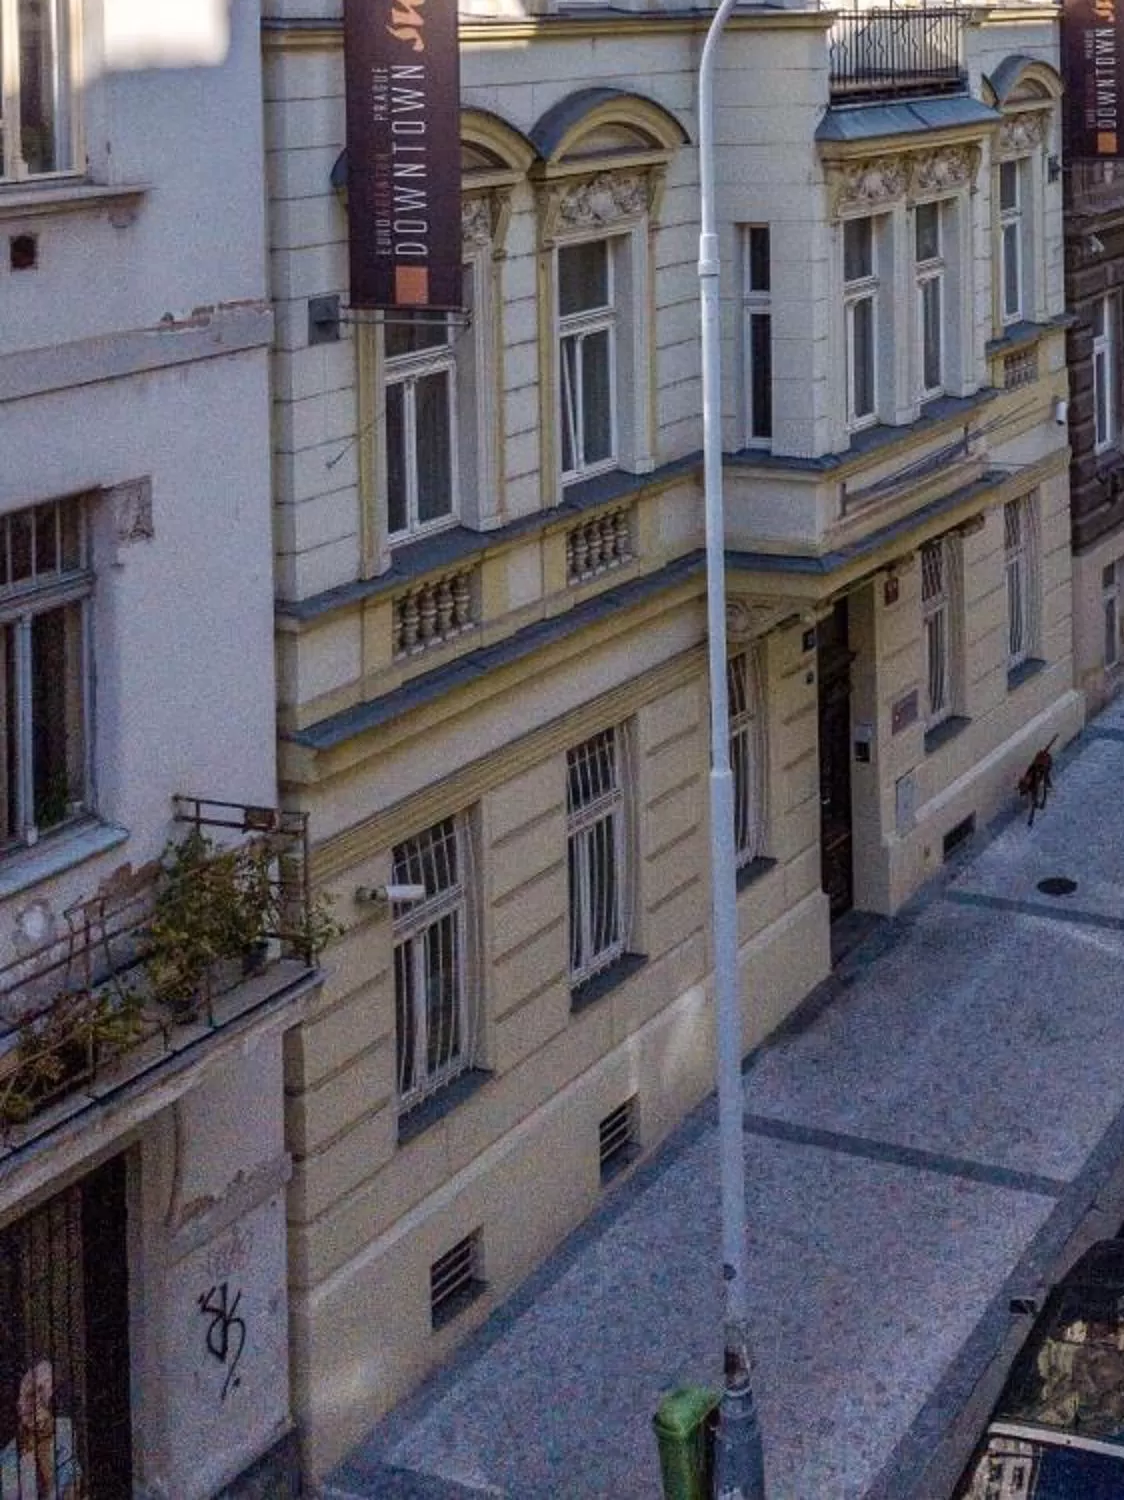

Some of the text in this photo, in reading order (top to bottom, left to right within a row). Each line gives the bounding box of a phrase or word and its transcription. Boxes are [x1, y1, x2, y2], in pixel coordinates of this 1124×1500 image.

[371, 67, 390, 122] PRAGUE
[1094, 27, 1118, 129] DOWNTOWN
[390, 64, 429, 257] DOWNTOWN
